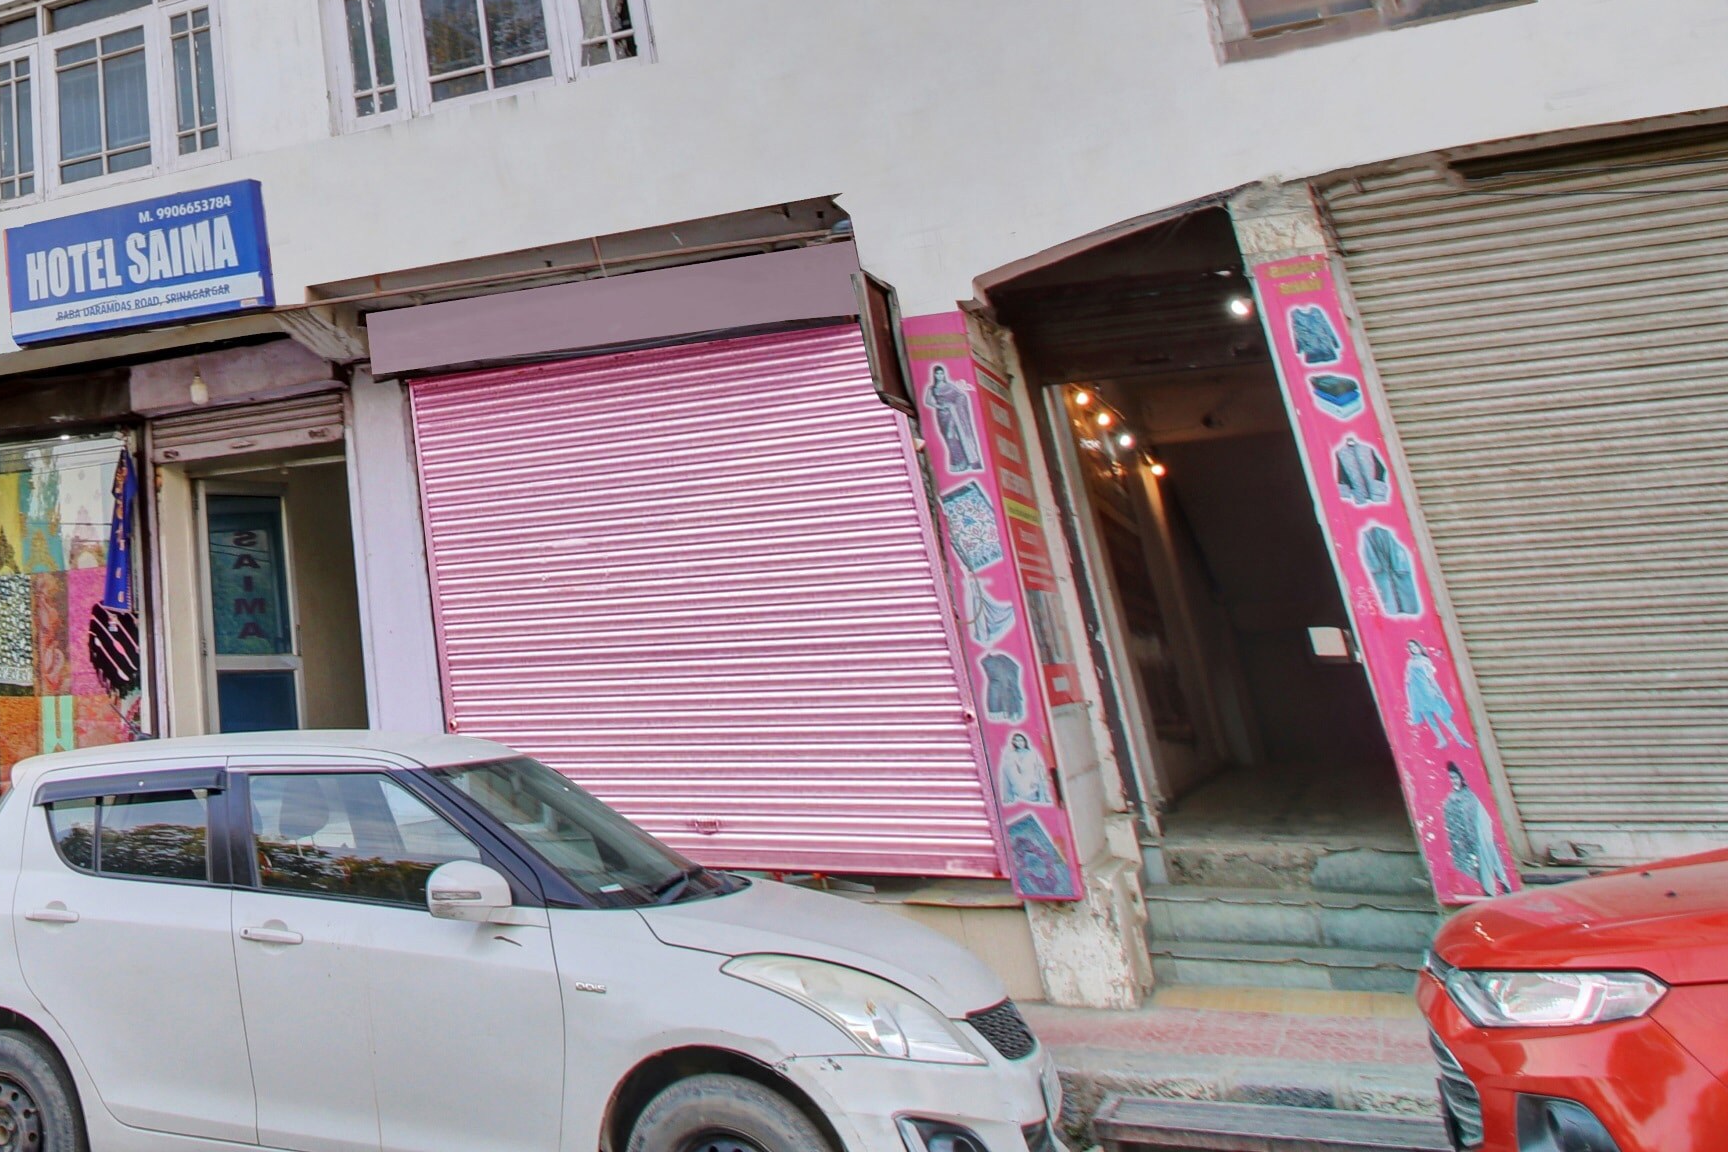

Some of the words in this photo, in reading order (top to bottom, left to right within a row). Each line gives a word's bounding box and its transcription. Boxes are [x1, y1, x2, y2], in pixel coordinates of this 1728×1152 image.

[138, 211, 154, 224] M.
[156, 195, 232, 219] 9906653784
[26, 238, 123, 301] HOTEL
[125, 215, 239, 284] SAIMA
[83, 300, 132, 317] DARAMDAS
[134, 296, 163, 310] ROAD,
